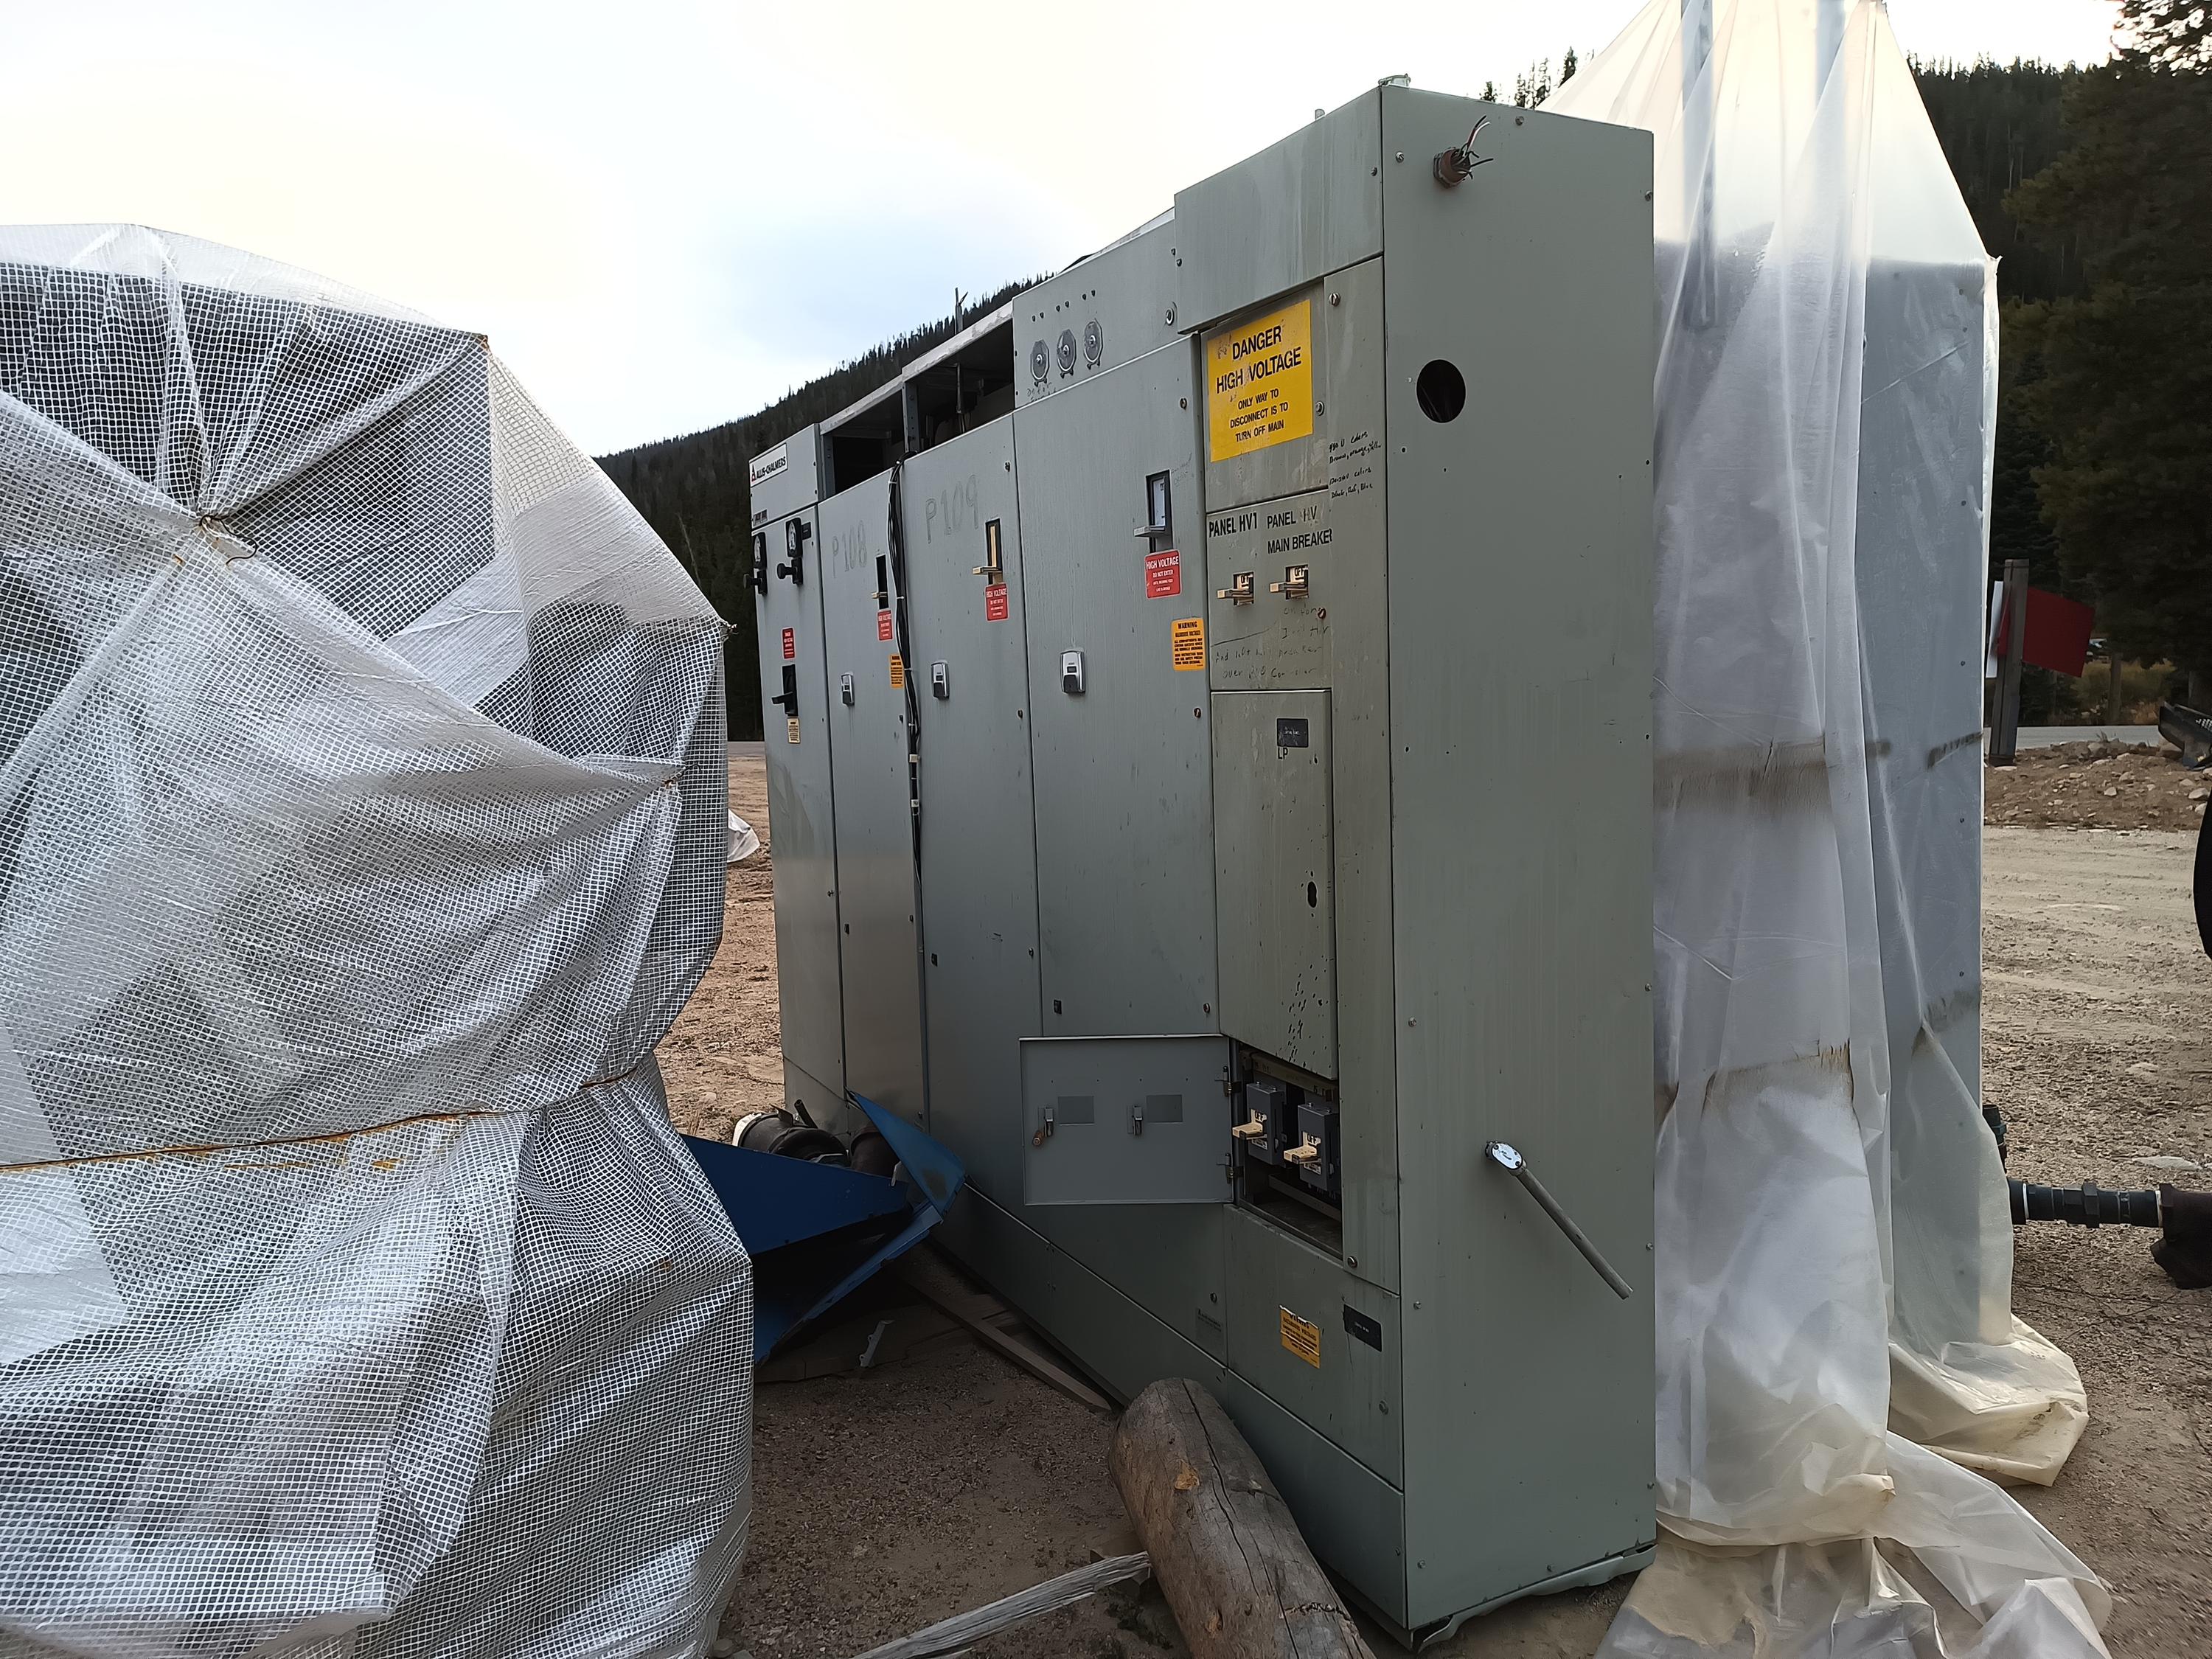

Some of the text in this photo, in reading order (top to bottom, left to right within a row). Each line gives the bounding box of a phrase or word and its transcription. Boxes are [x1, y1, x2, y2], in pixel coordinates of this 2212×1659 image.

[1232, 325, 1281, 360] DANGER
[1217, 347, 1301, 394] HIGH VOLTAGE
[1238, 389, 1279, 409] ONLY WAY TO
[1230, 402, 1288, 428] DISCONNECT IS TO
[1235, 420, 1284, 442] TURN OFF MAIN
[925, 474, 978, 544] P109
[1267, 511, 1296, 529] PANEL
[1209, 512, 1257, 538] PANEL HV1
[1267, 528, 1332, 554] MAIN BREAKER
[1146, 556, 1179, 570] HIGH VOLTAGE
